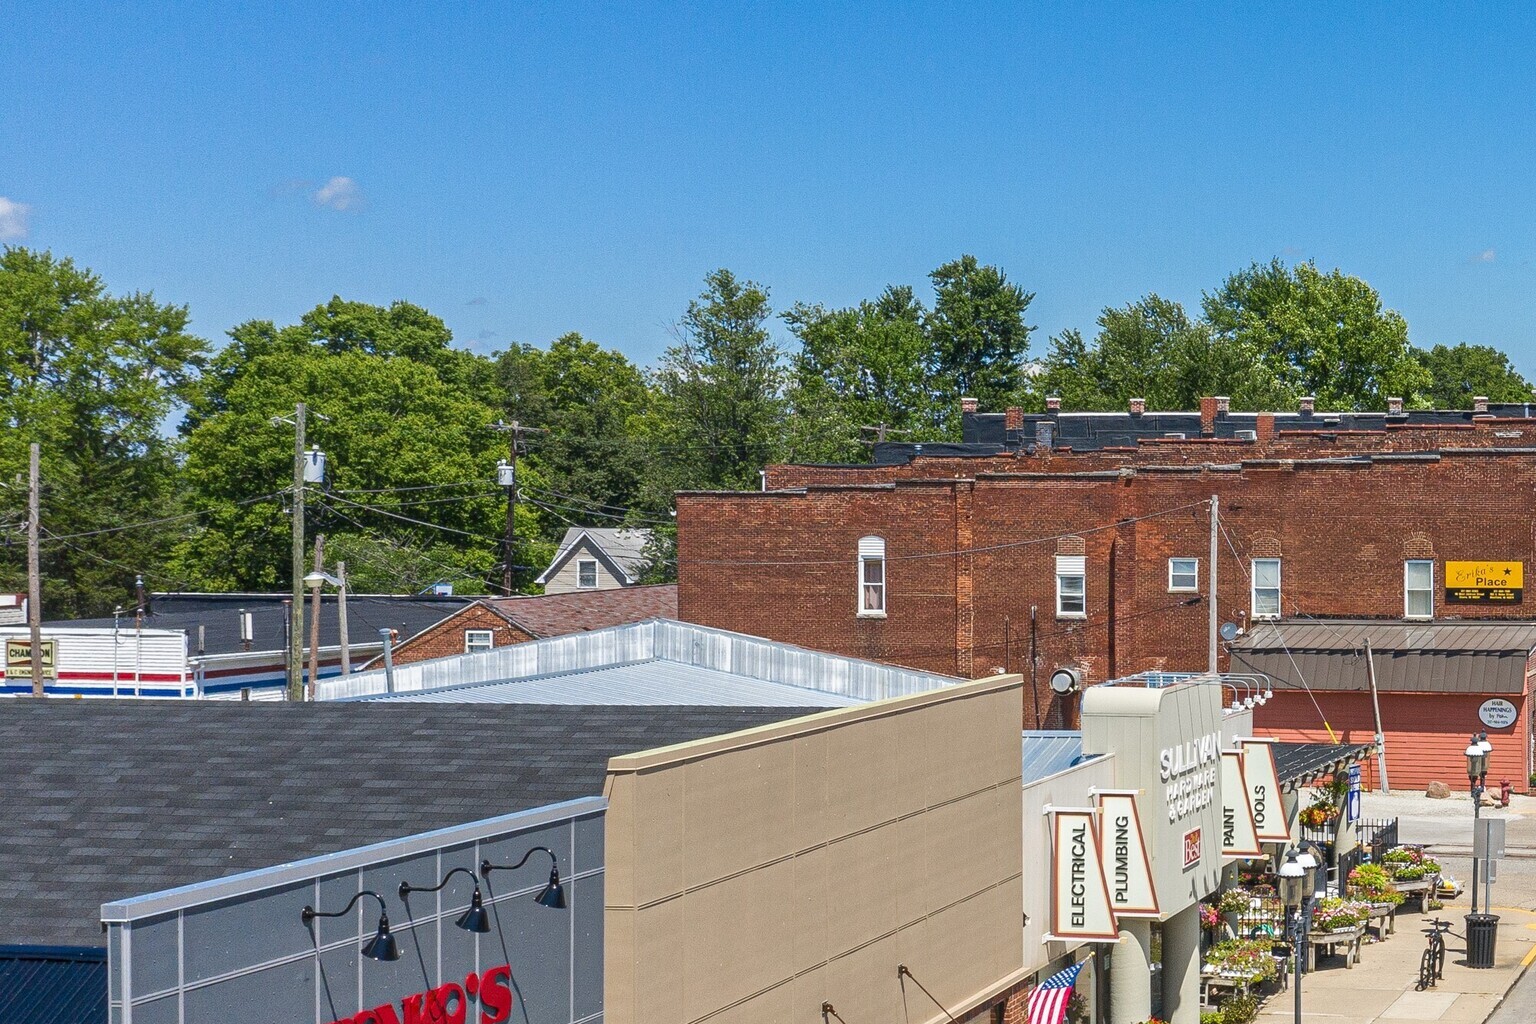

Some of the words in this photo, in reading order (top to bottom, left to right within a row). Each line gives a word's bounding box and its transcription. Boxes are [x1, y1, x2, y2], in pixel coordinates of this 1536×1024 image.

[1476, 577, 1508, 586] Place
[1160, 731, 1221, 779] SULLIVAN
[1167, 767, 1215, 800] HARDWARE
[1169, 803, 1177, 822] &
[1177, 788, 1214, 816] GARDEN
[1254, 785, 1265, 829] TOOLS
[1223, 806, 1234, 847] PAINT
[1115, 816, 1129, 903] PLUMBING
[1184, 838, 1200, 863] Best
[1071, 823, 1086, 928] ELECTRICAL
